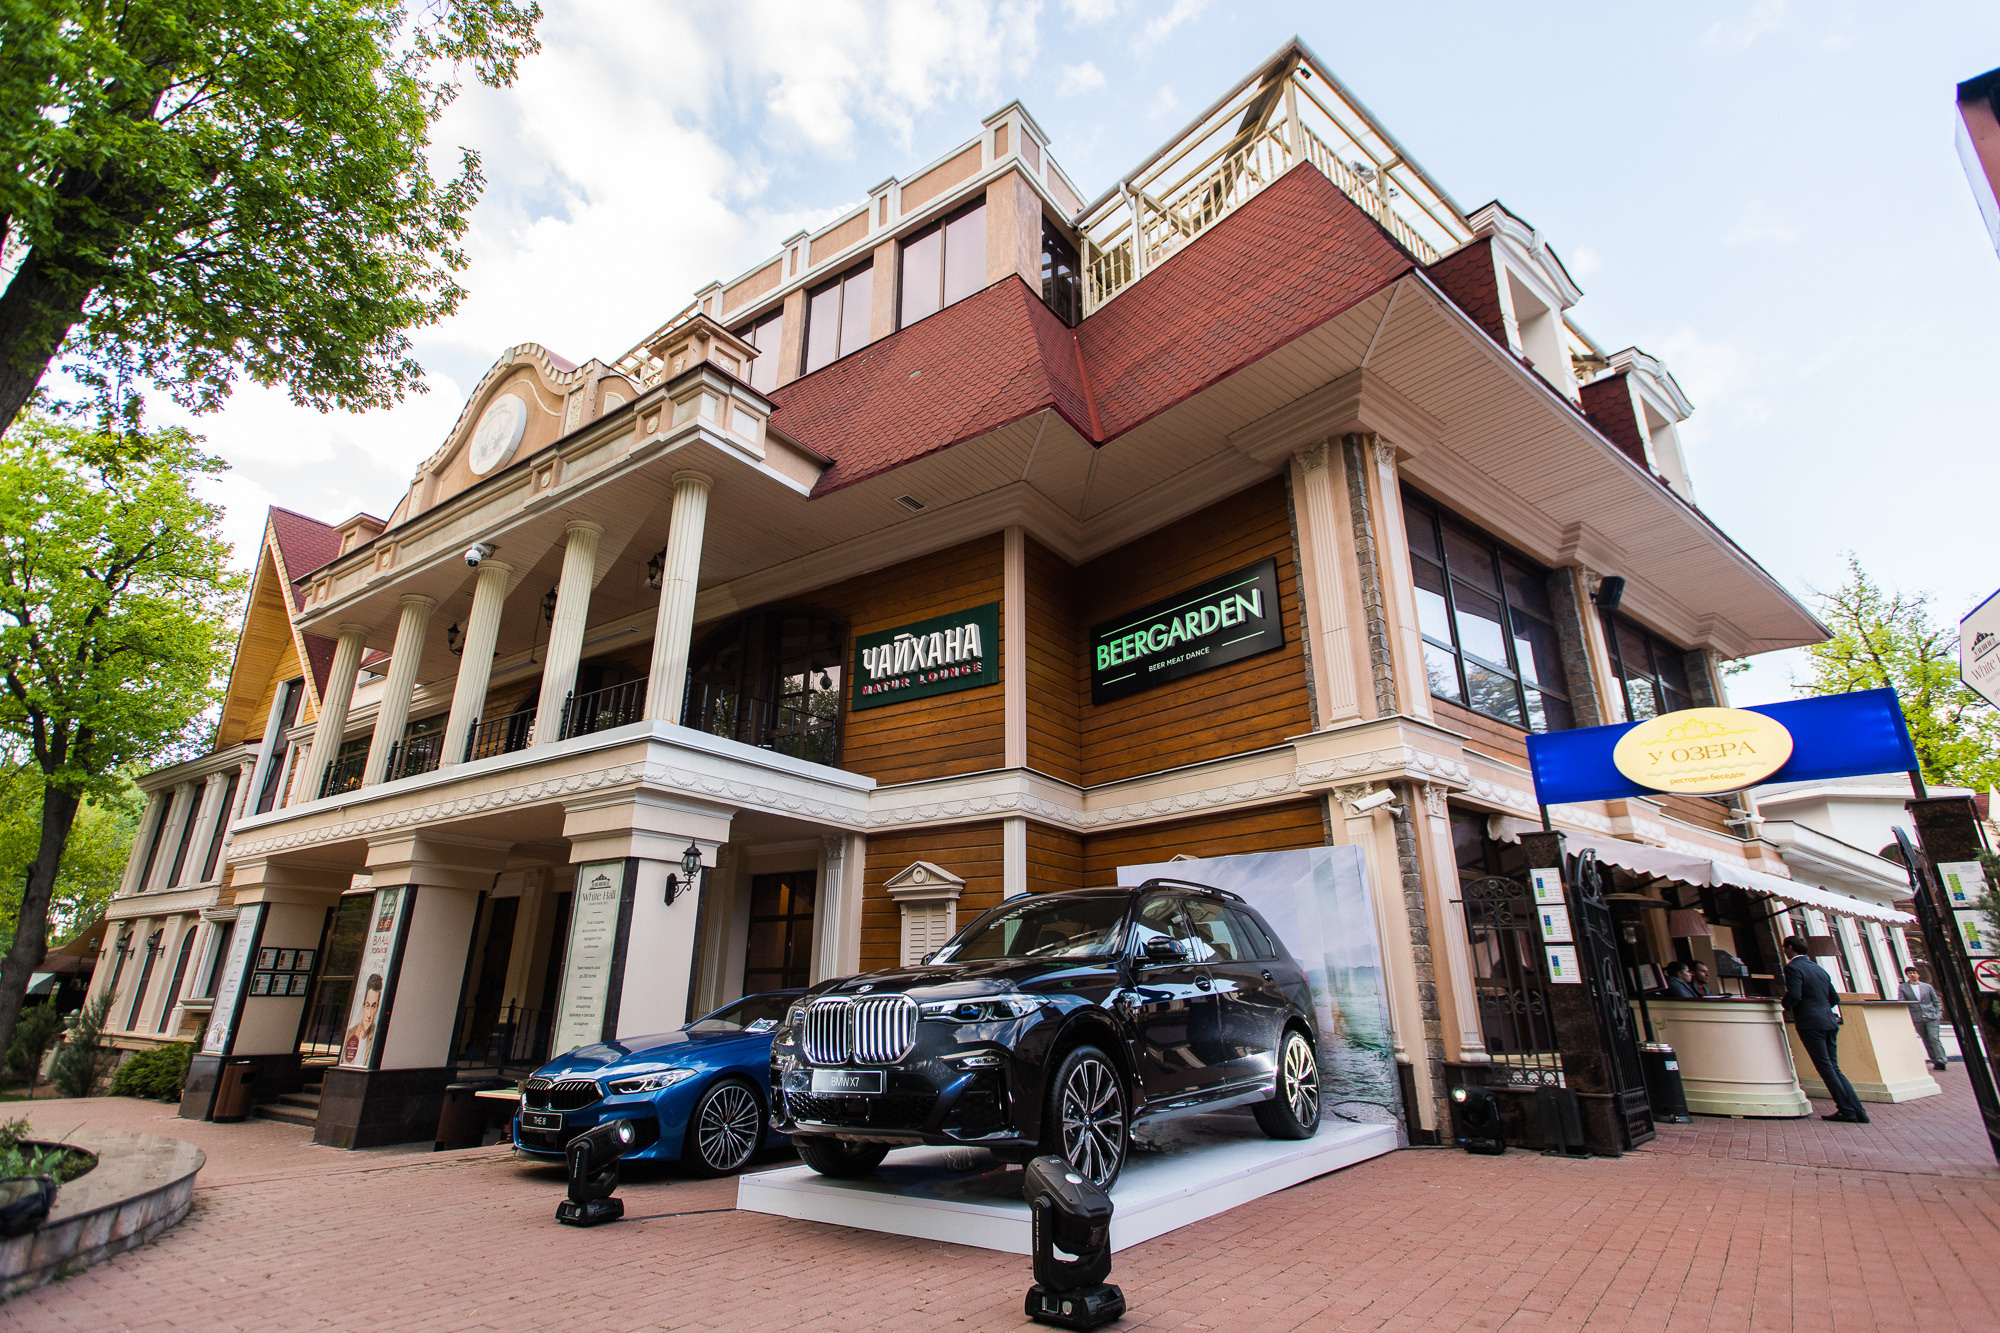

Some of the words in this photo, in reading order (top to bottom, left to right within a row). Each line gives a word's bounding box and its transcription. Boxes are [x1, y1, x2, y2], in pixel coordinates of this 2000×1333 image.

[1097, 588, 1264, 671] BEERGARDEN
[862, 623, 983, 680] ЧАЙХАНА
[1148, 661, 1166, 672] BEER
[1166, 654, 1185, 667] MEAT
[1185, 646, 1210, 660] DANCE
[862, 677, 911, 696] MATUR
[918, 661, 982, 685] LOUNGE
[1971, 658, 1998, 681] White
[1648, 751, 1663, 766] У
[1671, 740, 1757, 763] ОЗЕРА
[1669, 775, 1709, 786] ресторан
[1709, 771, 1747, 781] беседок
[582, 891, 602, 902] White
[602, 889, 617, 900] Hall
[831, 1077, 849, 1087] BMW
[848, 1076, 860, 1087] X7
[533, 1116, 543, 1125] THE
